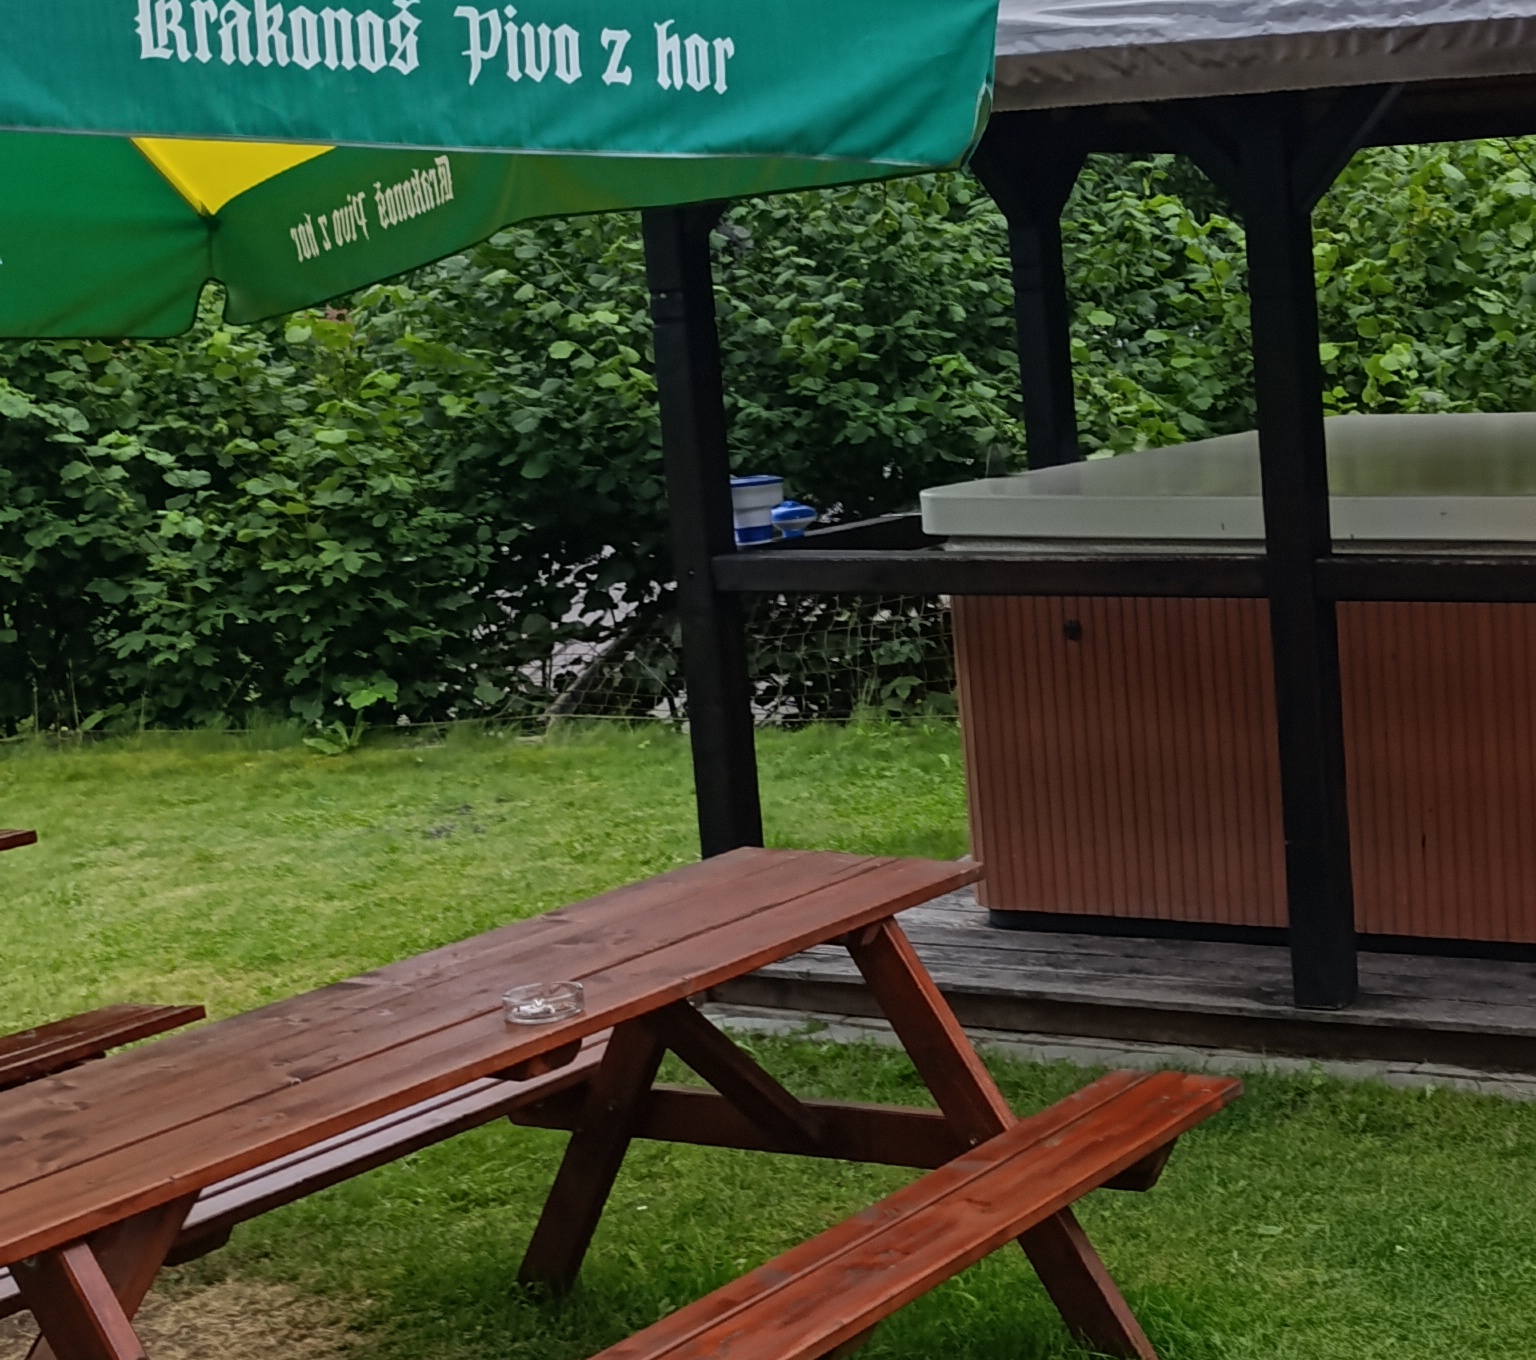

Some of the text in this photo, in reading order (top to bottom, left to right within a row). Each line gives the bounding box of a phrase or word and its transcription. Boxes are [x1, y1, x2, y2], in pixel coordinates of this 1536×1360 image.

[453, 4, 582, 86] Pivo
[601, 27, 632, 86] z
[653, 19, 735, 94] hor
